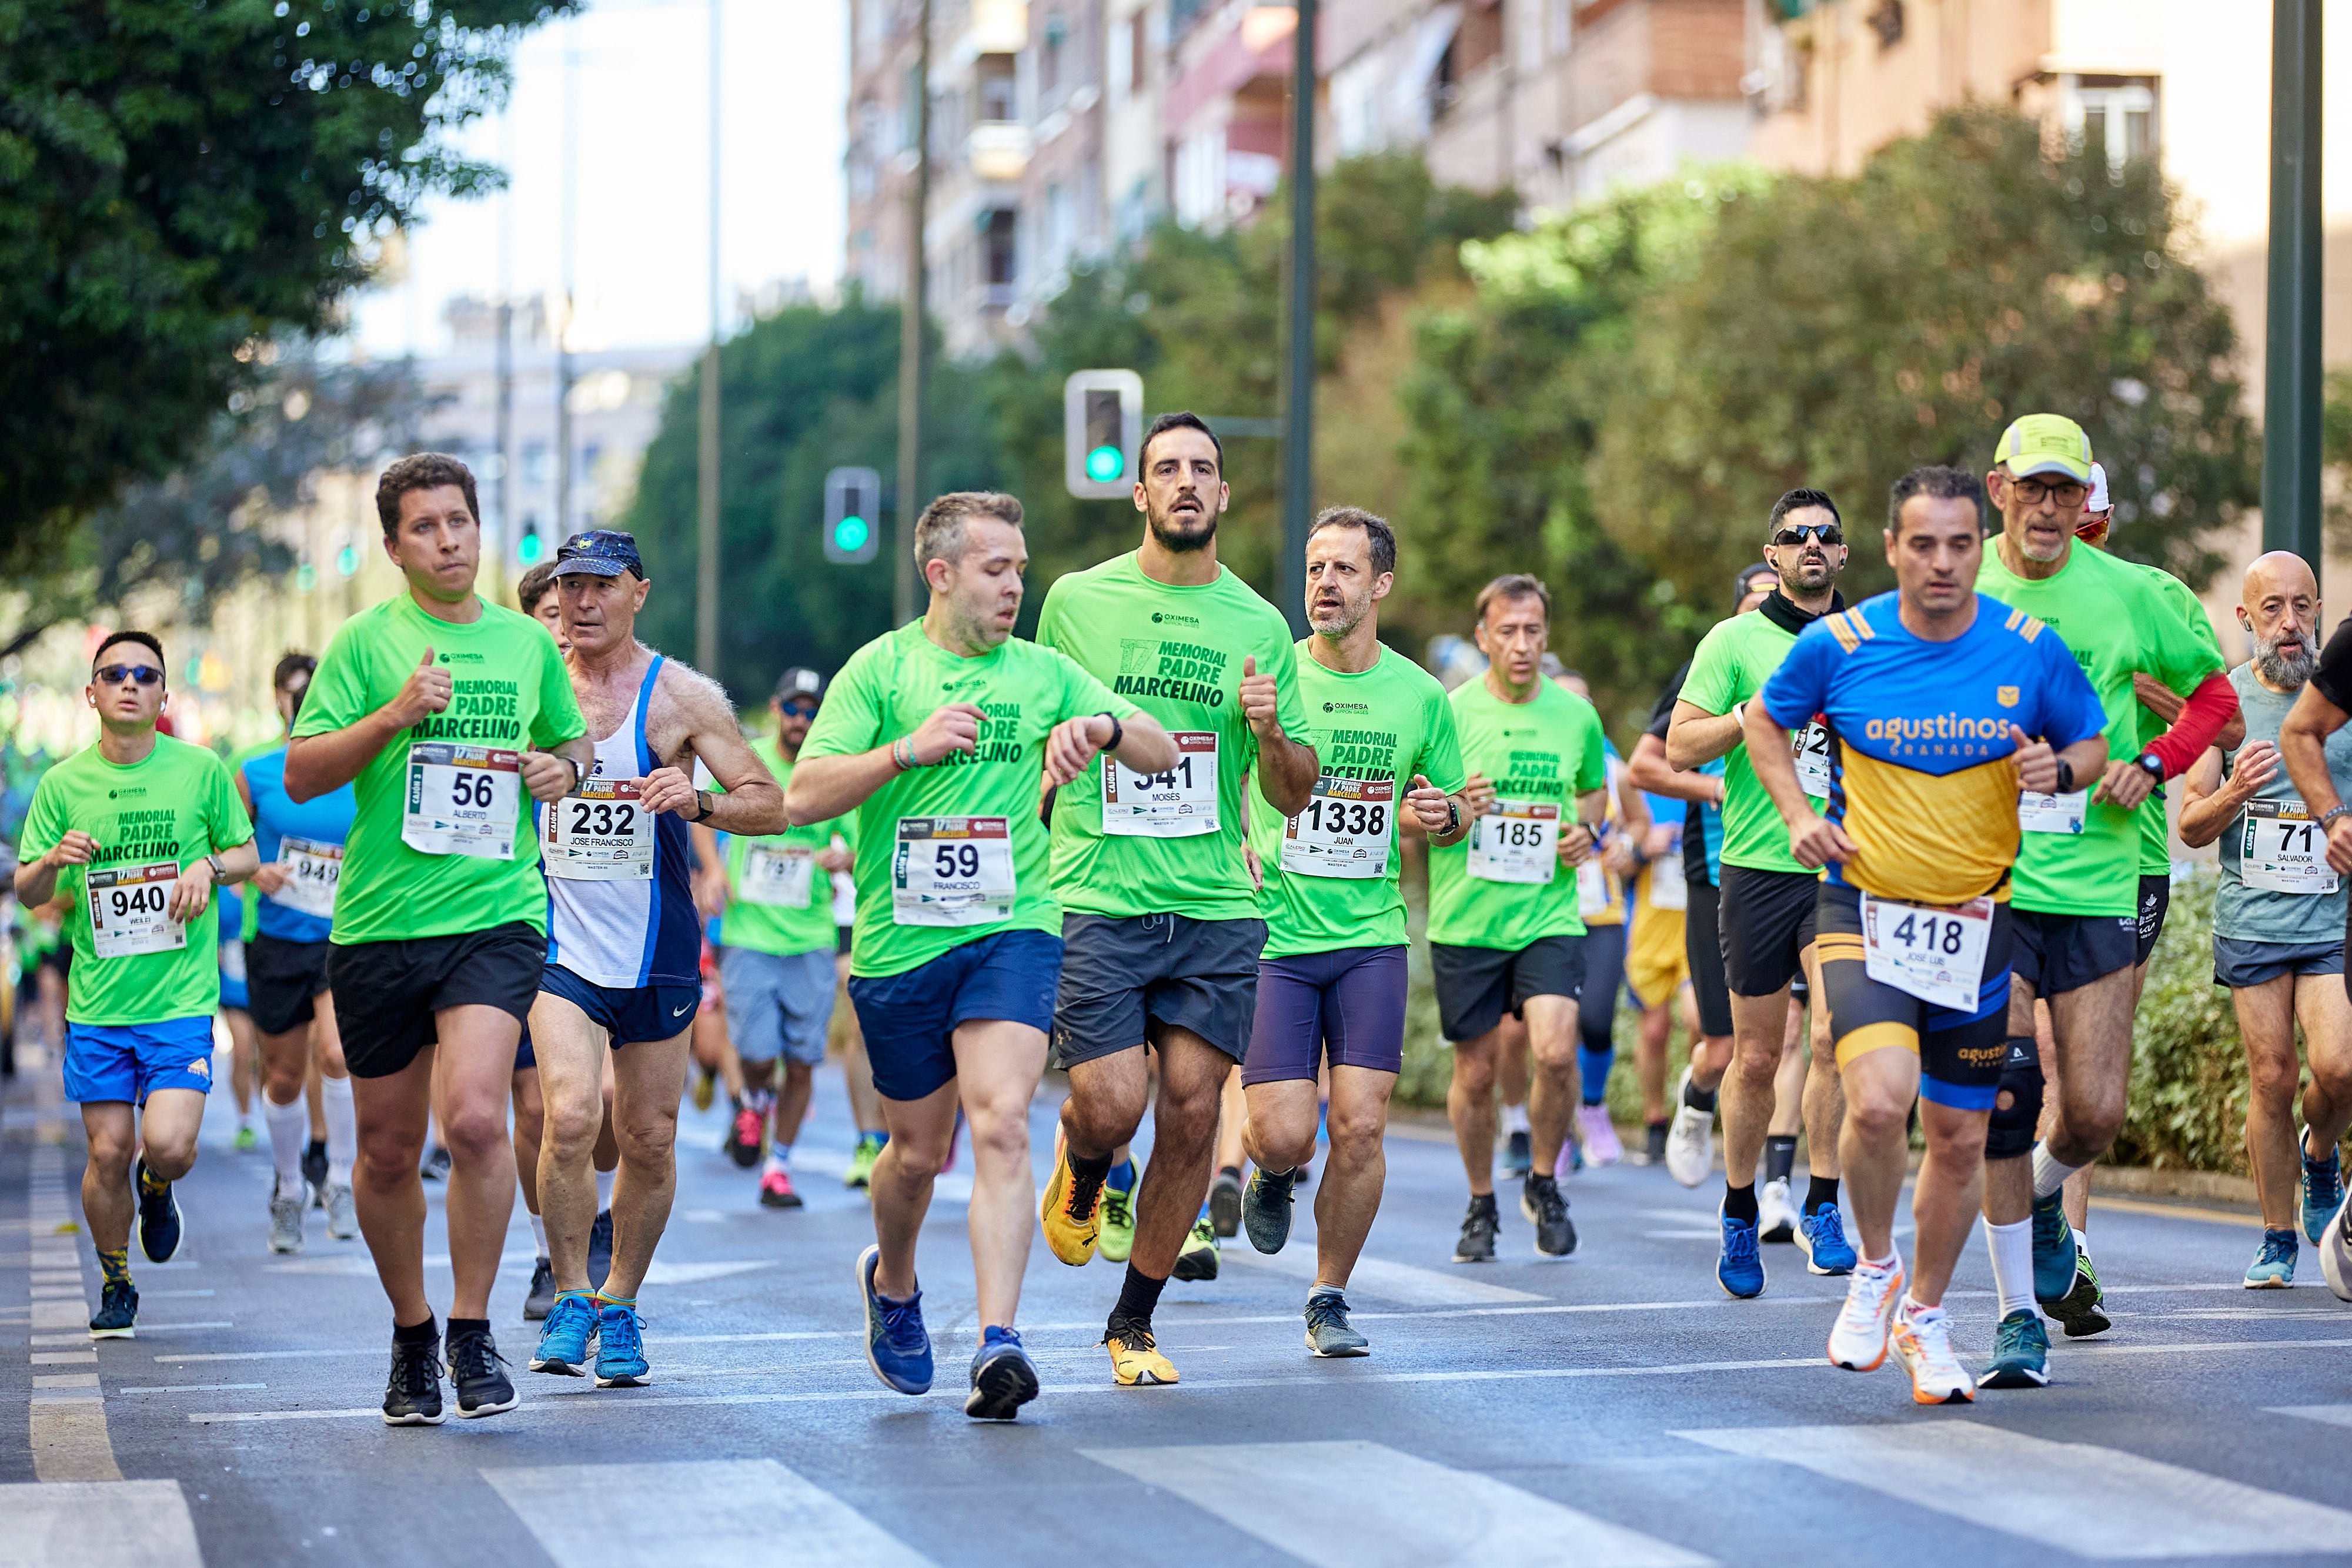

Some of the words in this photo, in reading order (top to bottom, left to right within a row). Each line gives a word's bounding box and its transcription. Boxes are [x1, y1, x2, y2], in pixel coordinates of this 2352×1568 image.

[1164, 614, 1200, 624] OXIMESA
[1120, 638, 1161, 674] 17
[1158, 641, 1227, 667] MEMORIAL
[1158, 657, 1222, 686] PADRE
[453, 680, 519, 696] MEMORIAL
[1114, 676, 1223, 707] MARCELINO
[456, 696, 517, 717] PADRE
[979, 703, 1021, 718] ORIAL
[410, 717, 520, 740] MARCELINO
[980, 720, 1018, 741] DRE
[1866, 711, 2010, 748] agustinos
[1331, 730, 1397, 748] MEMORIAL
[454, 745, 466, 758] 17
[1331, 745, 1394, 767] PADRE
[1889, 744, 1989, 757] GRANADA
[452, 772, 493, 808] 56
[583, 780, 594, 791] 17
[1108, 771, 1116, 794] CAJÓN
[1330, 779, 1342, 790] 17
[1492, 780, 1563, 795] ARCELINO
[1152, 791, 1180, 801] MOISÉS
[1327, 790, 1362, 798] MARCELINO
[453, 810, 487, 820] ALBERTO
[2280, 802, 2290, 813] 17
[118, 809, 175, 825] MEMORIAL
[571, 803, 634, 835] 232
[1307, 800, 1384, 835] 1338
[119, 824, 173, 842] PADRE
[570, 837, 589, 845] JOSE
[1334, 837, 1354, 845] JUAN
[1496, 821, 1542, 846] 185
[2279, 824, 2312, 852] 71
[90, 842, 179, 864] MARCELINO
[936, 844, 979, 878] 59
[2277, 854, 2313, 863] SALVADOR
[934, 881, 980, 890] FRANCISCO
[112, 886, 165, 916] 940
[130, 917, 151, 925] WEILEI
[1893, 912, 1963, 954] 418
[1929, 956, 1946, 967] LUIS
